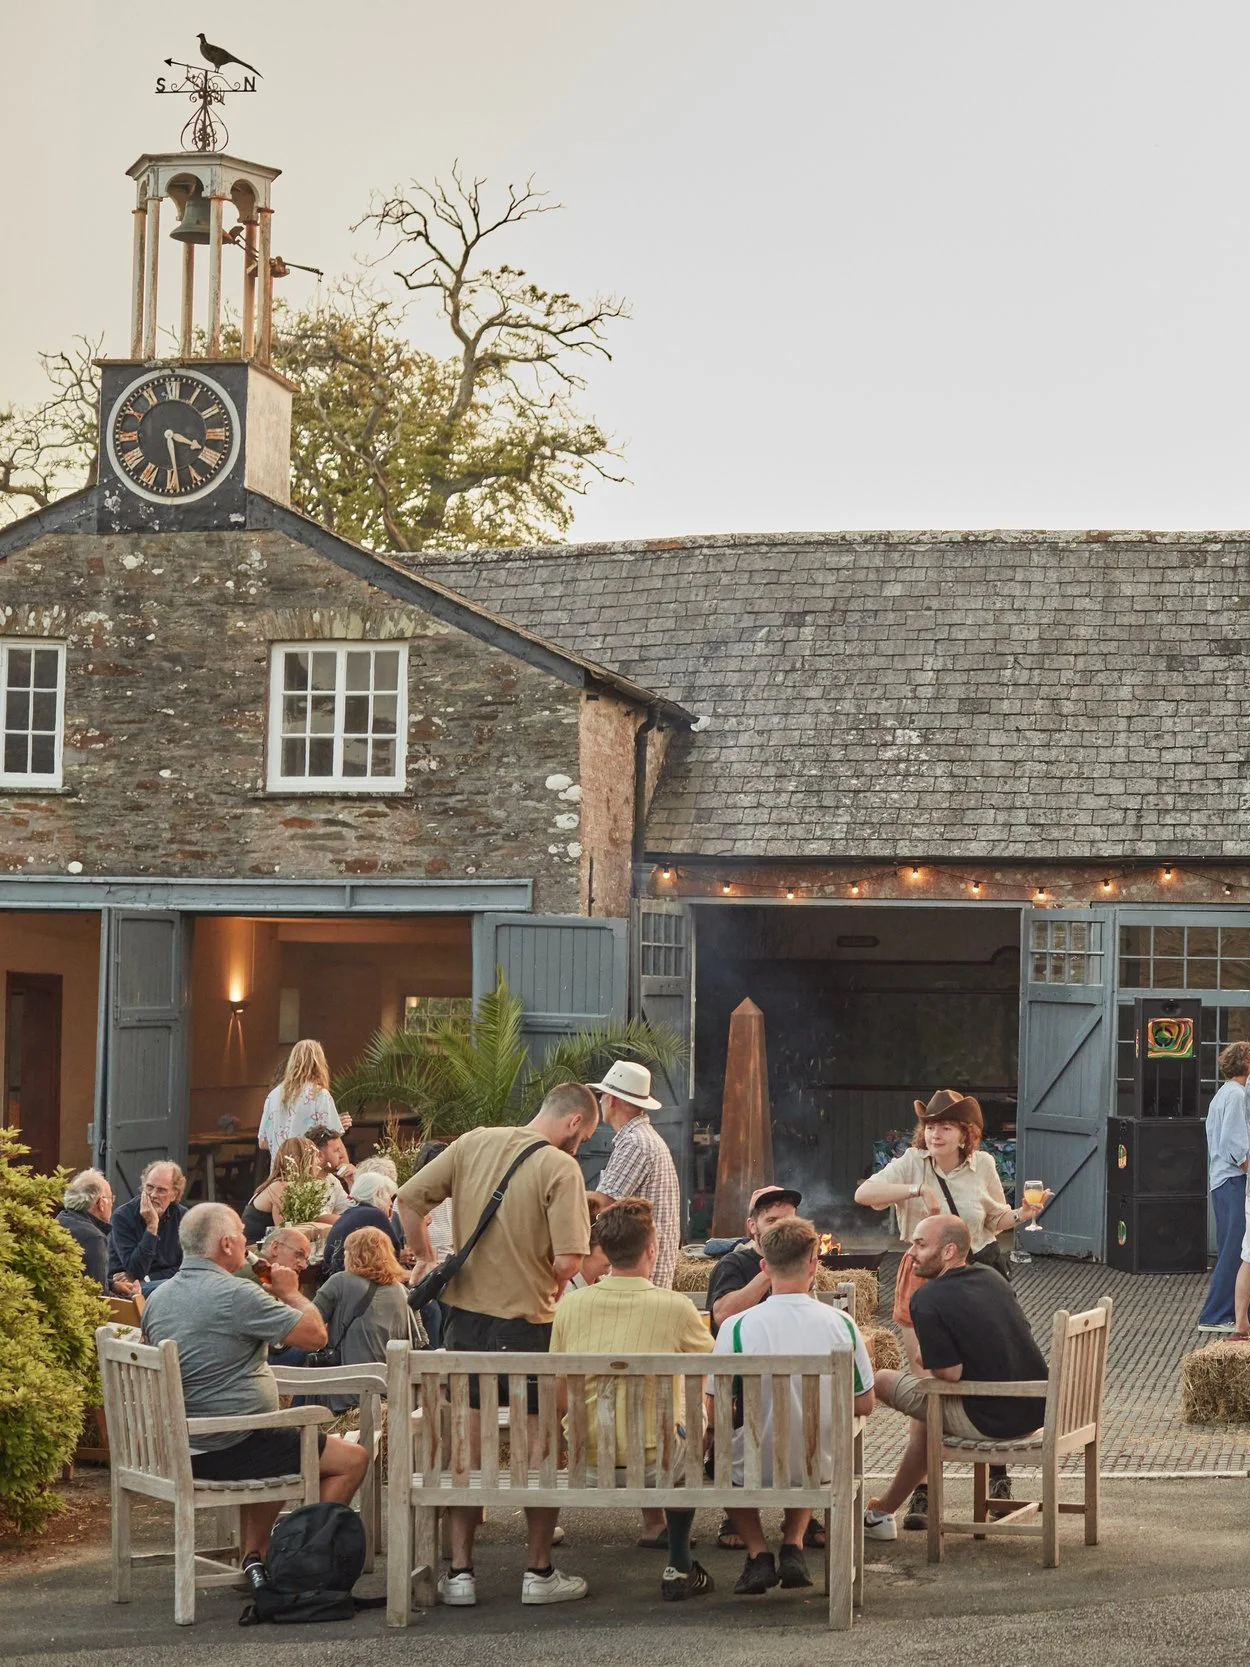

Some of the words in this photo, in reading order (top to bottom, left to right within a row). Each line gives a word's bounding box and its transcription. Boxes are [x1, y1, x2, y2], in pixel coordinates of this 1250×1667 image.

[156, 77, 166, 93] S
[244, 76, 255, 92] N
[187, 386, 201, 405] I
[126, 405, 144, 423] X
[201, 403, 220, 420] II
[206, 427, 225, 441] III
[188, 464, 202, 484] V
